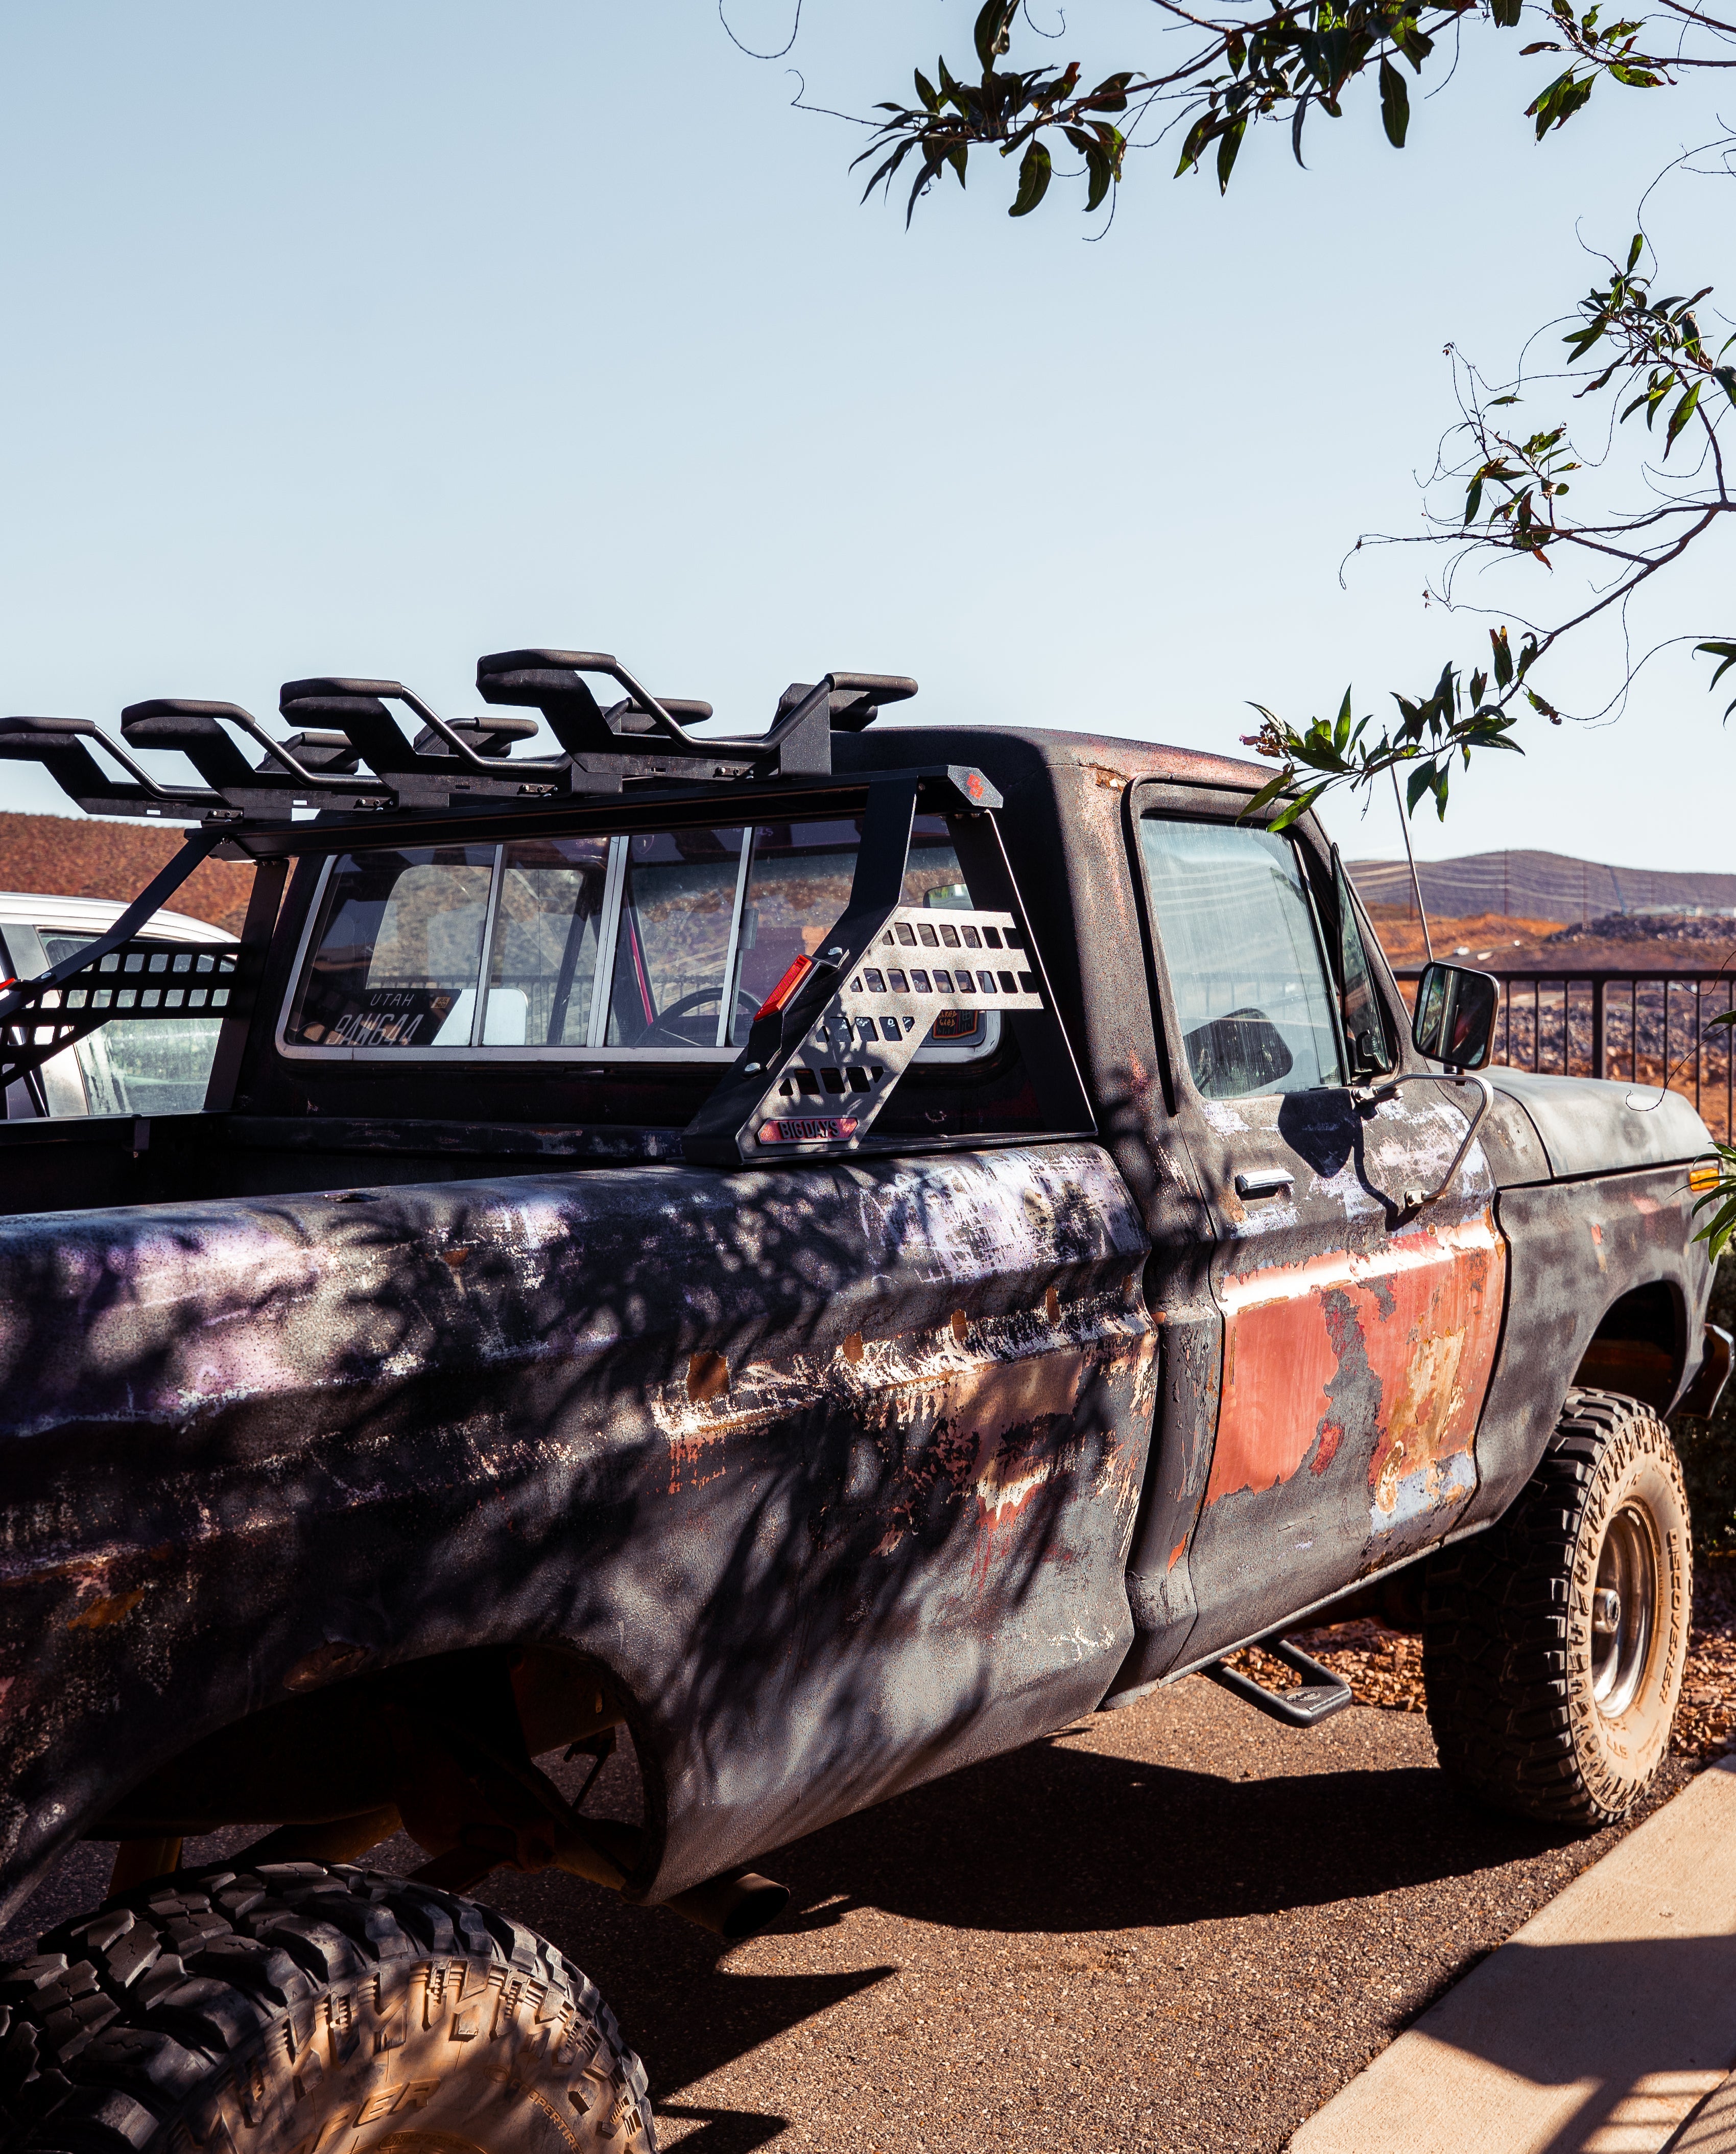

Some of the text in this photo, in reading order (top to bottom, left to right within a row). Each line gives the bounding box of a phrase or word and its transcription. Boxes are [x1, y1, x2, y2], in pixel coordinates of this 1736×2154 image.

[370, 993, 415, 1006] UTAH
[323, 1013, 424, 1046] 9AW644
[1659, 1527, 1681, 1704] DISCOVERER
[511, 2077, 584, 2154] COOPERTIRE
